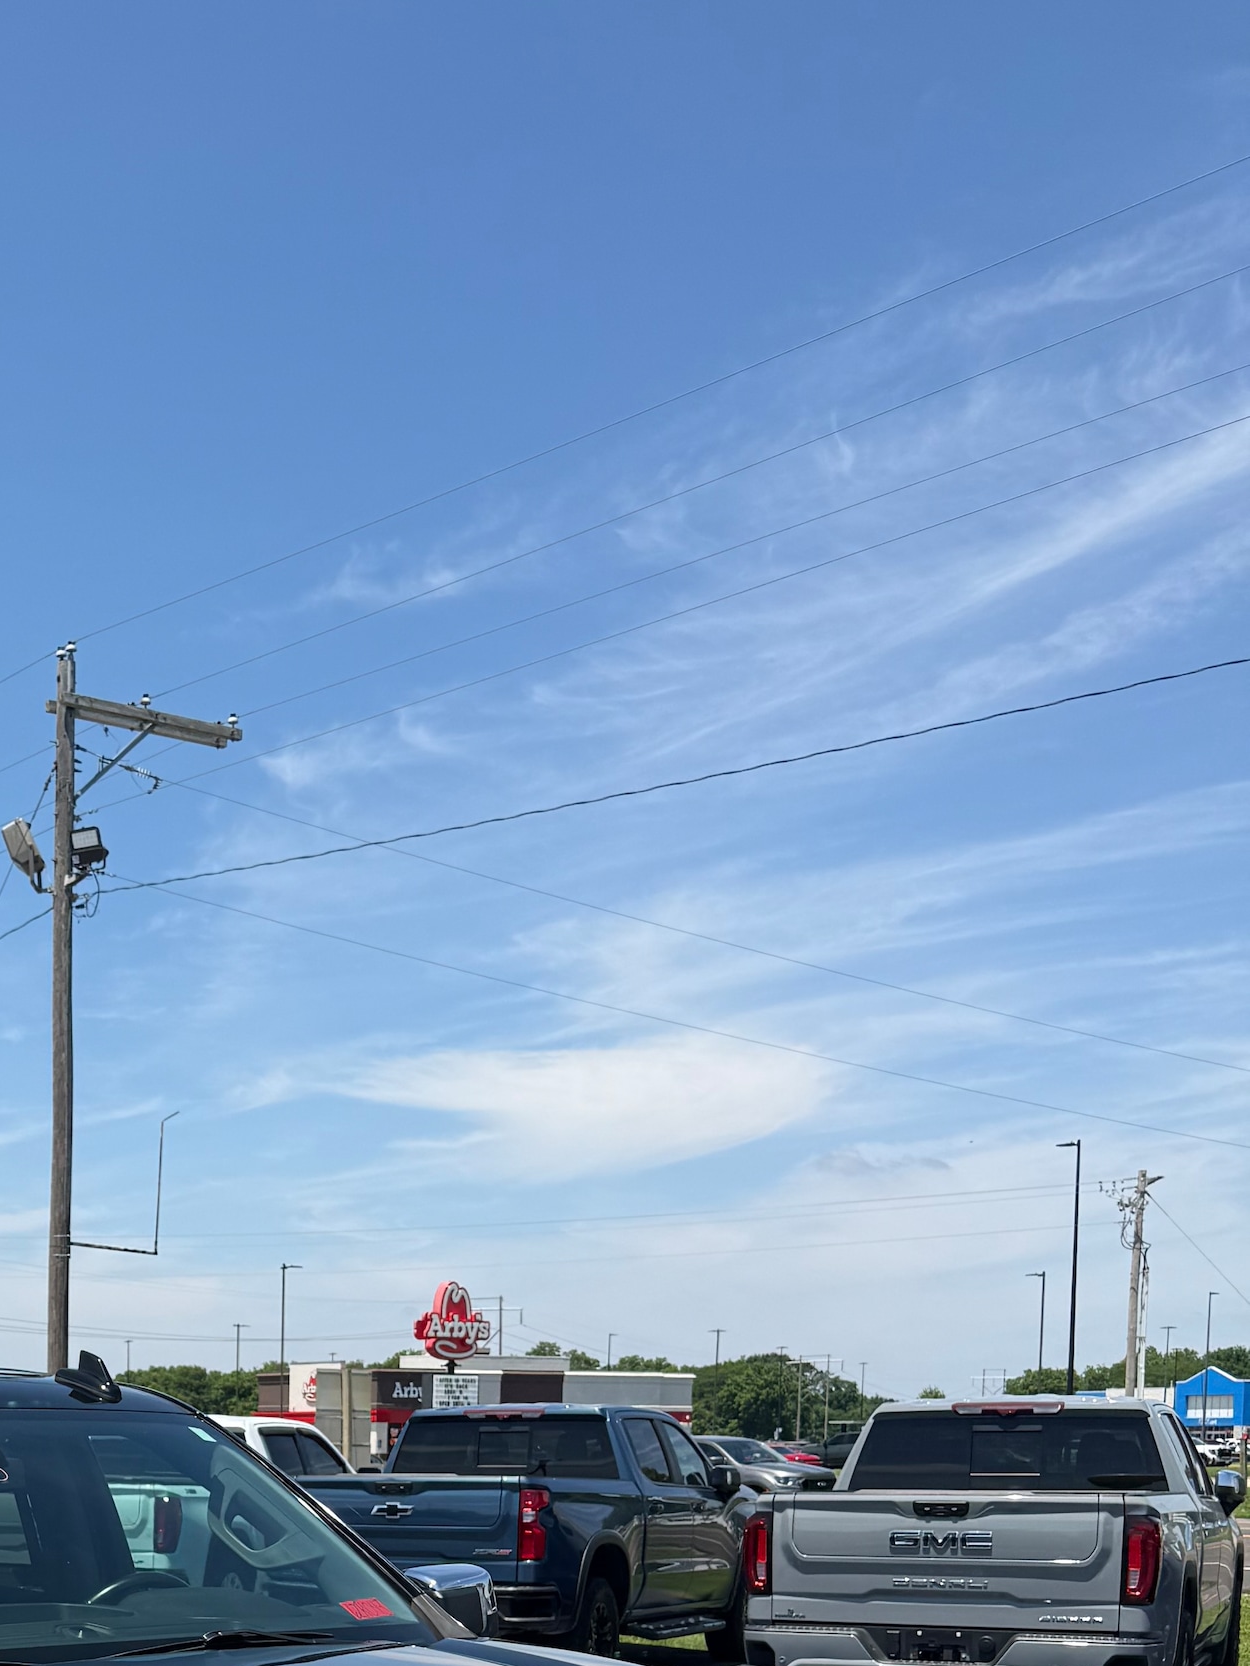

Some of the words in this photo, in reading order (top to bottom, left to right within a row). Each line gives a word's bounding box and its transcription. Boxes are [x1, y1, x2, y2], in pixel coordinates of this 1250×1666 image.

[427, 1313, 489, 1344] Arby's
[392, 1382, 422, 1402] Arby
[889, 1529, 992, 1550] GMC
[892, 1577, 989, 1589] DENALI
